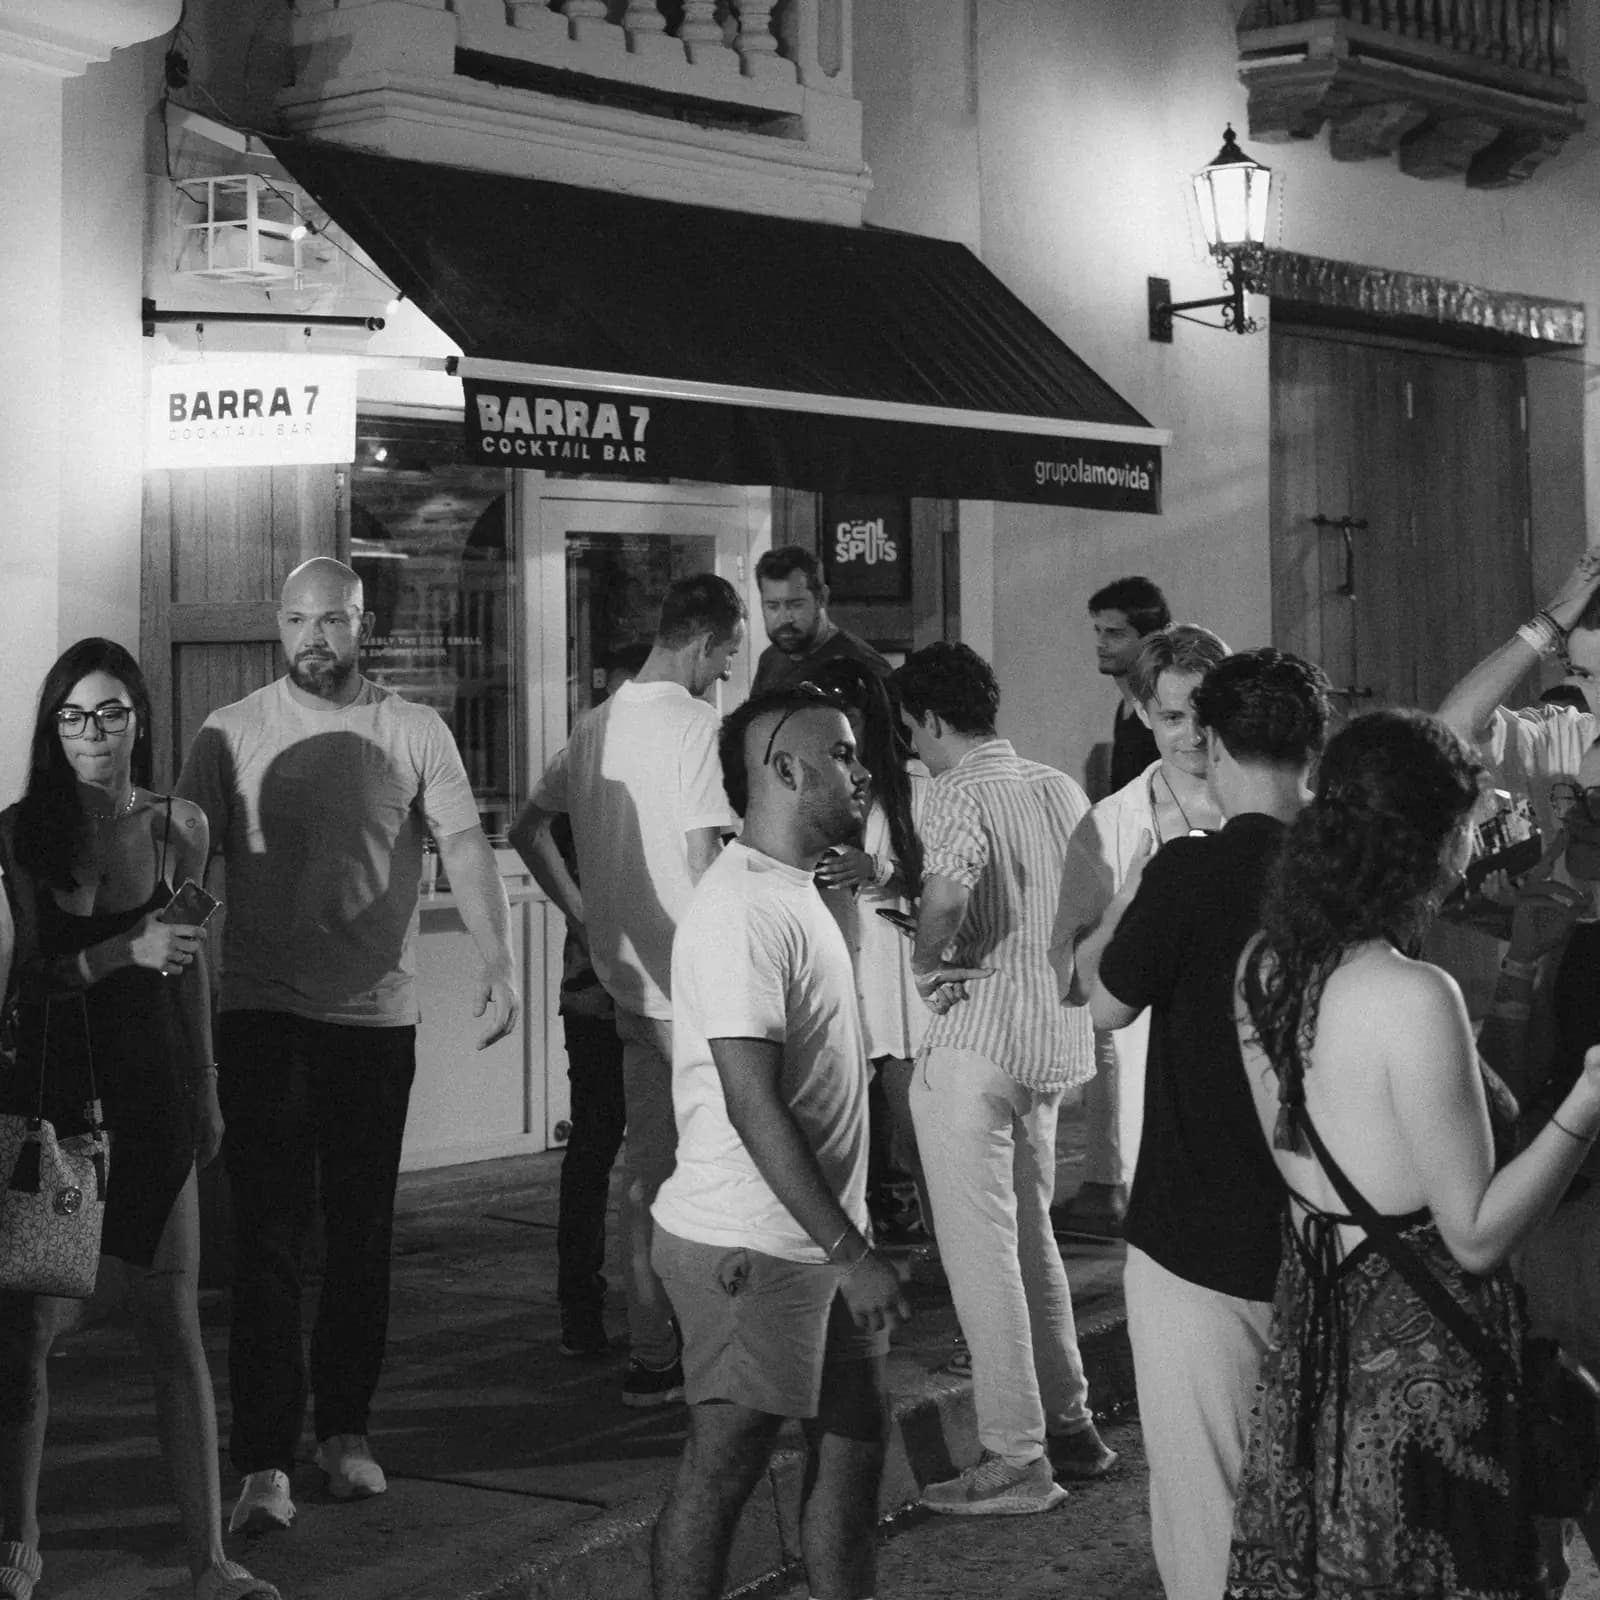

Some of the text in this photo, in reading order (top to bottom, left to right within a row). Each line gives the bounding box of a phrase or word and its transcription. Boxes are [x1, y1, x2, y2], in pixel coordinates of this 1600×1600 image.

[169, 385, 319, 422] BARRA 7
[276, 422, 313, 436] BAR
[476, 394, 650, 442] BARRA 7
[482, 436, 646, 462] COCKTAIL BAR
[836, 540, 897, 565] SPOTS
